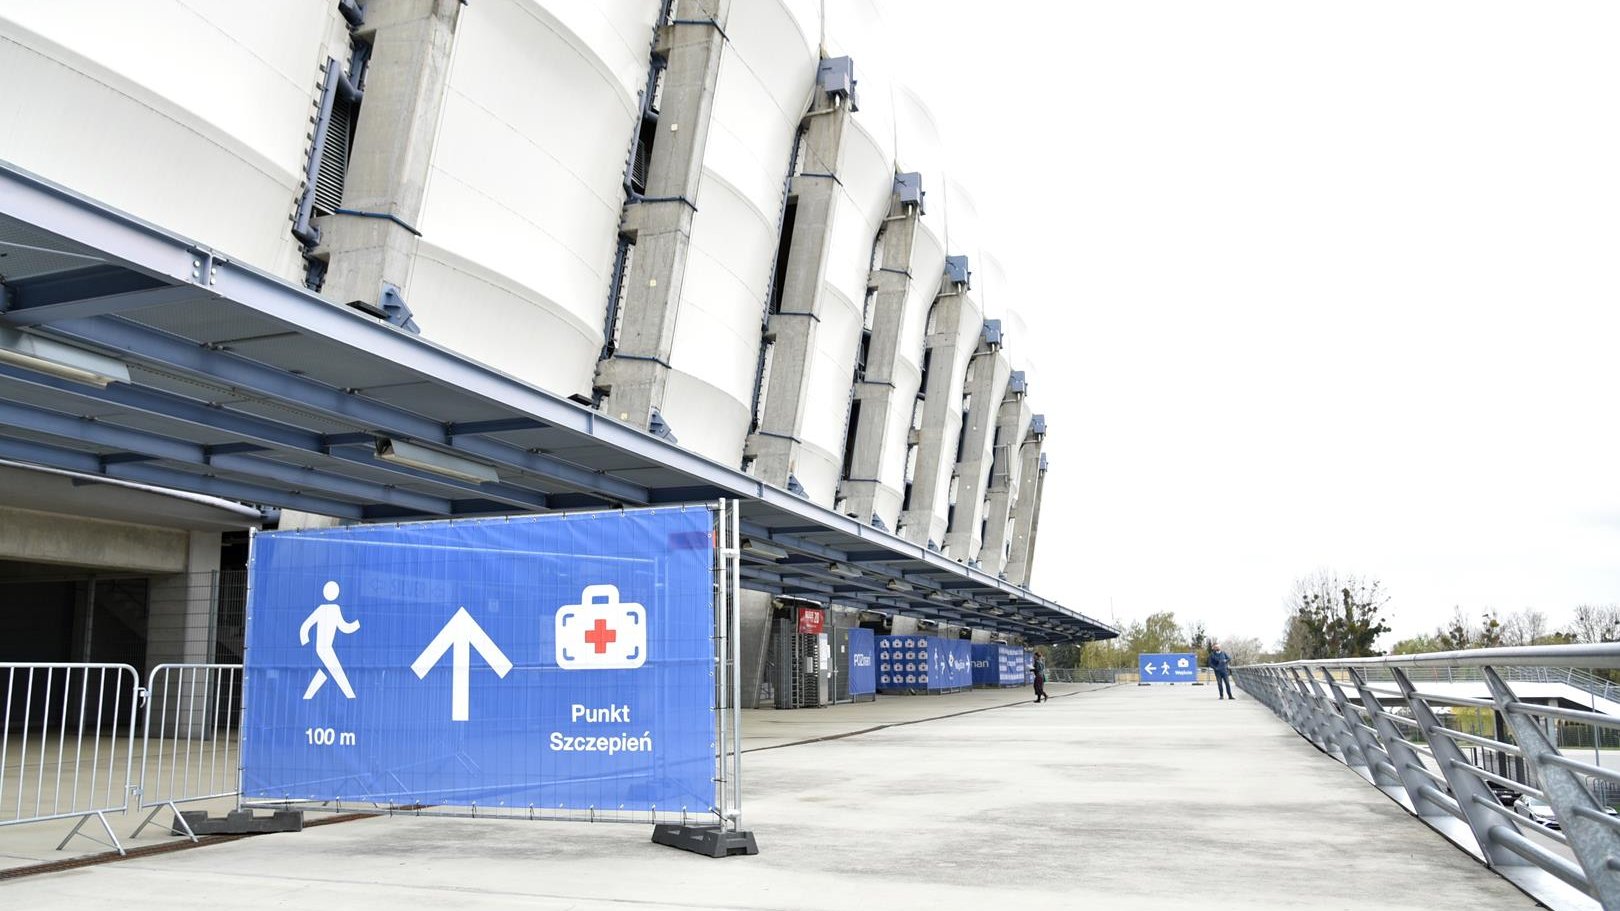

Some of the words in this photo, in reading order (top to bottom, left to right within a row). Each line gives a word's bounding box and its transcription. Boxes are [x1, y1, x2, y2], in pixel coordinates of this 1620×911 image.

[571, 703, 631, 723] Punkt
[305, 727, 336, 746] 100
[339, 732, 356, 746] m
[549, 730, 653, 756] Szczepień
